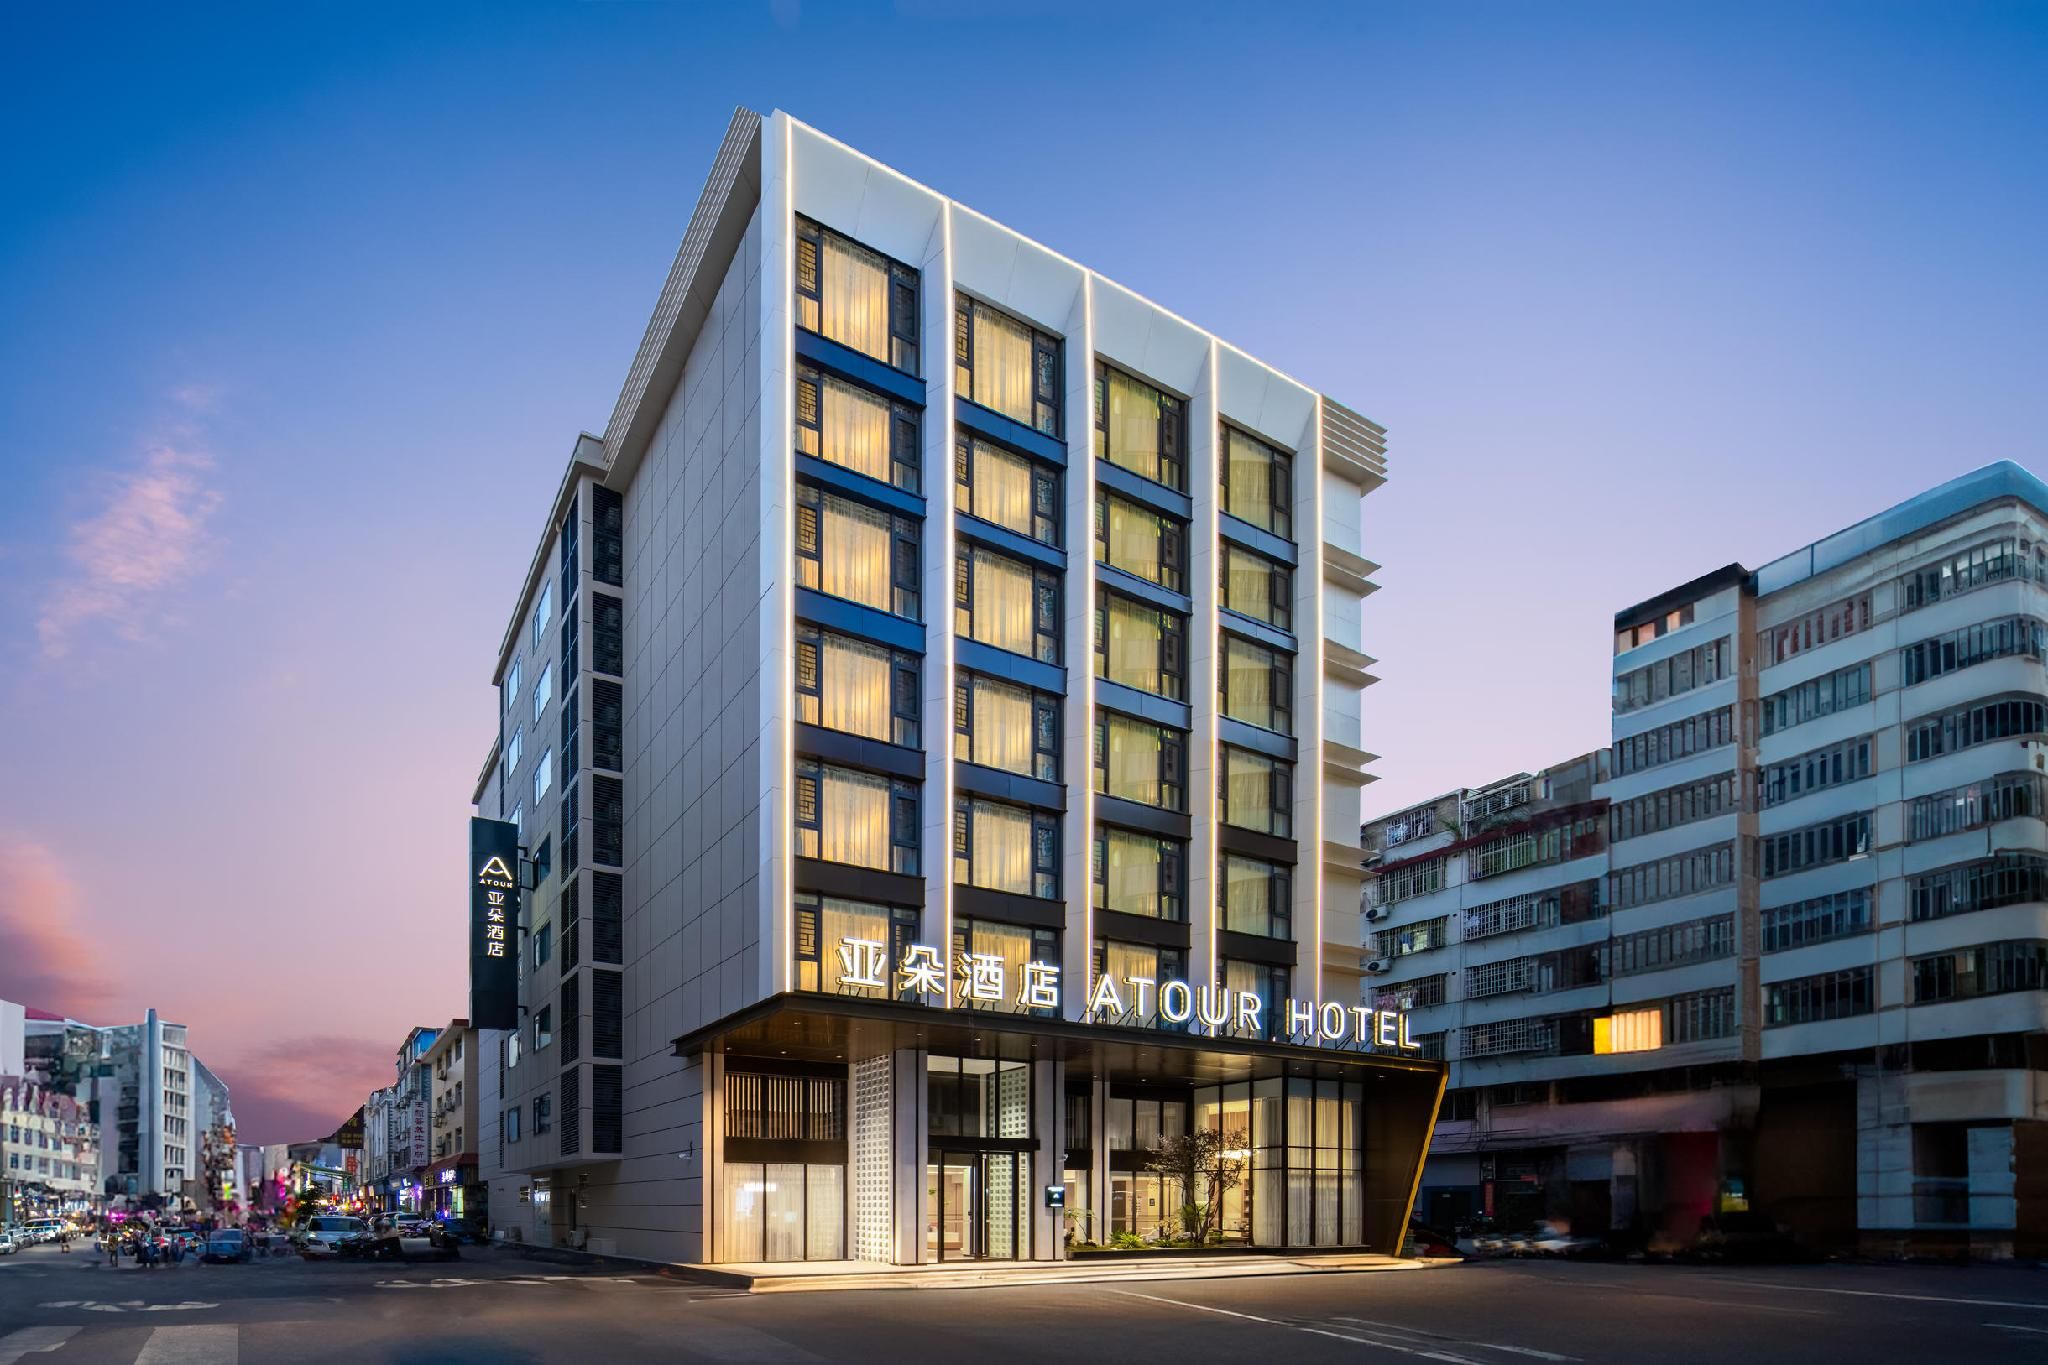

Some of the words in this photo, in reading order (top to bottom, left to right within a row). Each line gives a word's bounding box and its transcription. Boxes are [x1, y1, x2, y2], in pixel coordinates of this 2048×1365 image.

[479, 878, 513, 889] ATOUR
[487, 891, 504, 957] 亚朵酒店
[836, 937, 1060, 1008] 亚朵酒店
[1085, 973, 1262, 1031] ATOUR
[1286, 997, 1421, 1050] HOTEL
